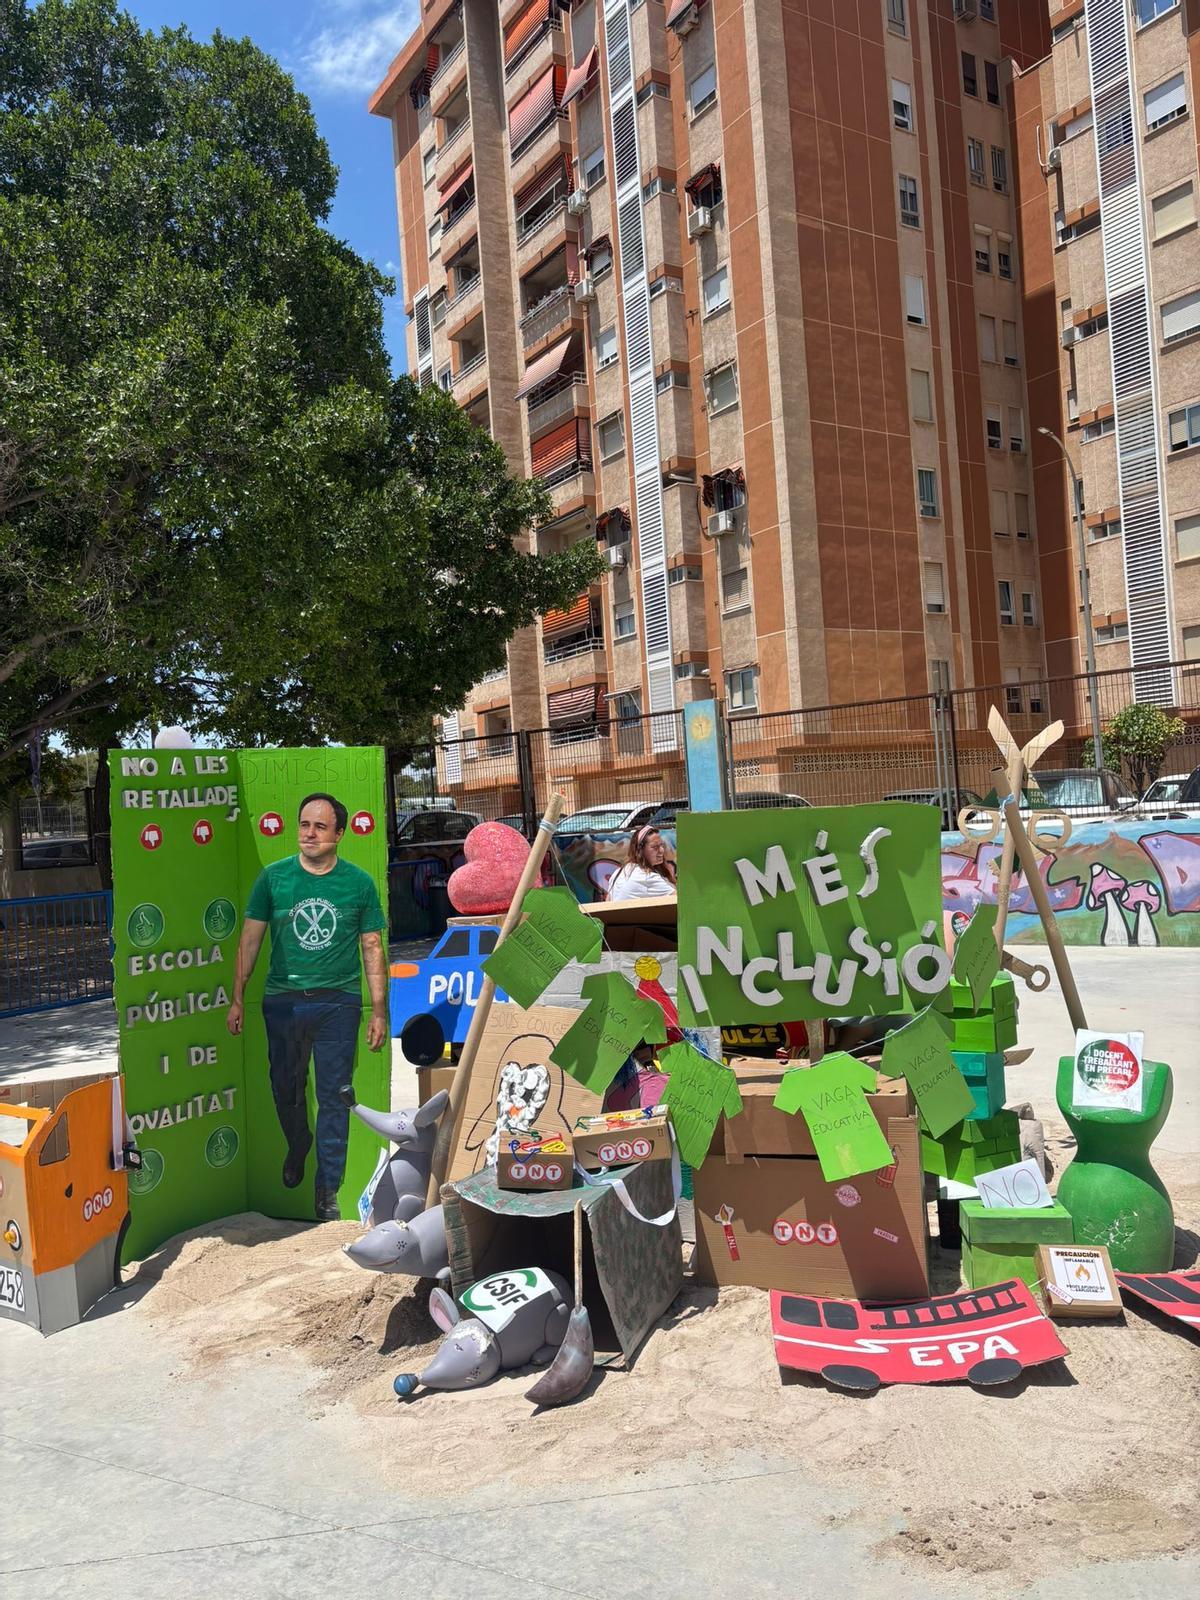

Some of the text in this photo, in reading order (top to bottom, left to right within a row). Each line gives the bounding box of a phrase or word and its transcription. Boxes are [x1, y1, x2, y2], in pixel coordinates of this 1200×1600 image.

[121, 756, 228, 776] NO A LES
[734, 827, 892, 906] MÉS
[537, 911, 571, 949] VAGA
[128, 945, 224, 976] ESCOLA
[678, 920, 951, 1013] INCLUSIÓ
[600, 1003, 628, 1028] VAGA
[584, 1017, 631, 1055] EDUCATIVA
[721, 1027, 781, 1044] ULZE
[161, 1046, 217, 1074] I DE
[909, 1046, 940, 1071] VAGA
[1083, 1056, 1134, 1068] TREBALLANT
[1093, 1049, 1125, 1060] DOCENT
[916, 1063, 959, 1097] EDUCATIVA
[1085, 1064, 1096, 1072] EN
[680, 1075, 714, 1097] VAGA
[812, 1085, 857, 1110] VAGA
[813, 1110, 871, 1136] EDUCATIVA
[602, 1141, 648, 1160] TNT
[512, 1164, 561, 1180] TNT
[982, 1169, 1040, 1207] NO
[84, 1188, 112, 1220] TNT
[775, 1223, 834, 1241] TNT
[1056, 1250, 1100, 1258] PRECAUCIÓN
[483, 1277, 529, 1306] CSIF
[910, 1335, 1019, 1367] EPA
